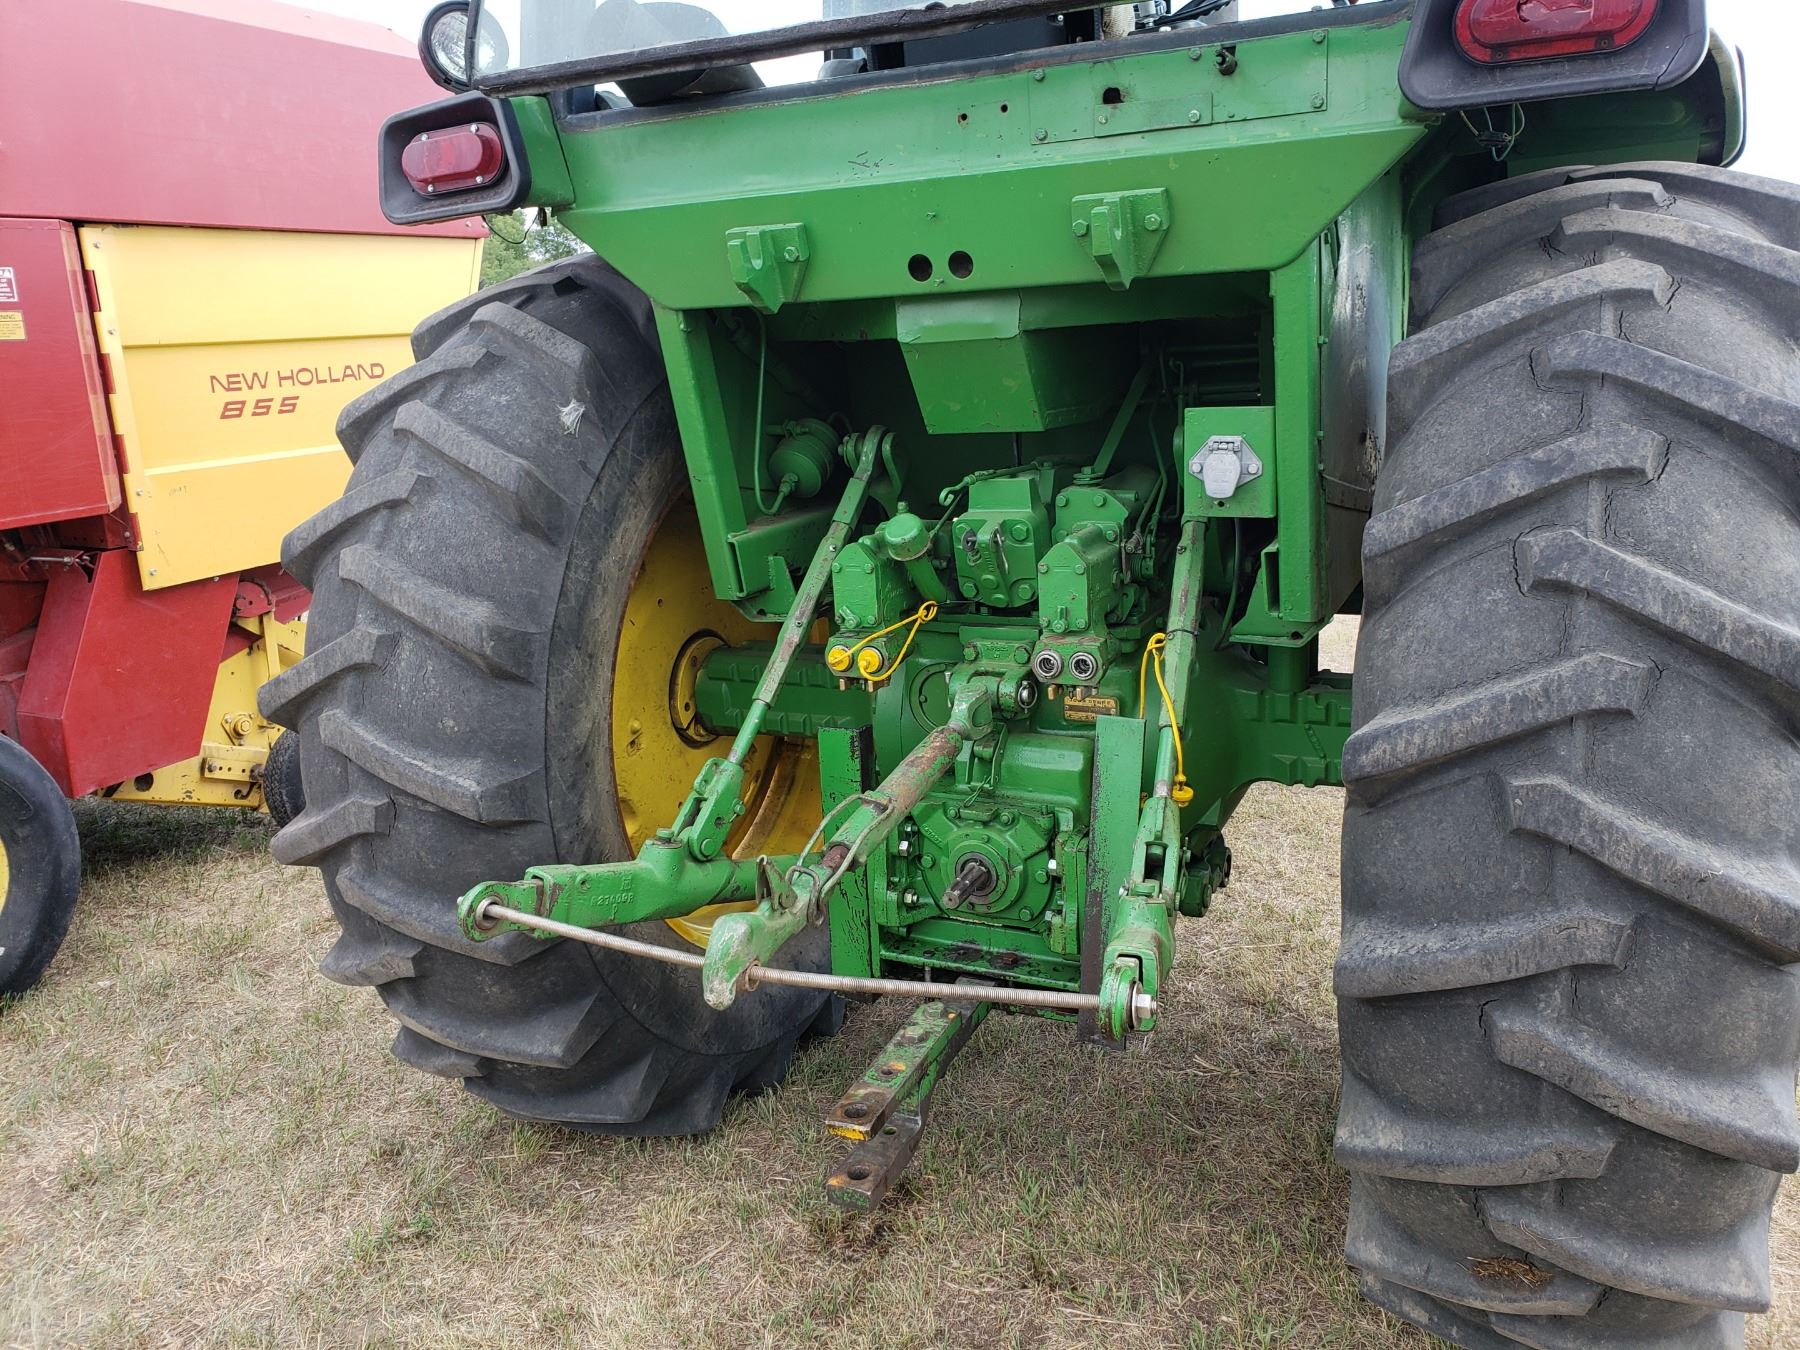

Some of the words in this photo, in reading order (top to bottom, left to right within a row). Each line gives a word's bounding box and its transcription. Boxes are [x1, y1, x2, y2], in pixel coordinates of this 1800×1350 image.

[209, 371, 269, 393] NEW
[277, 363, 385, 388] HOLLAND
[219, 395, 300, 420] 855
